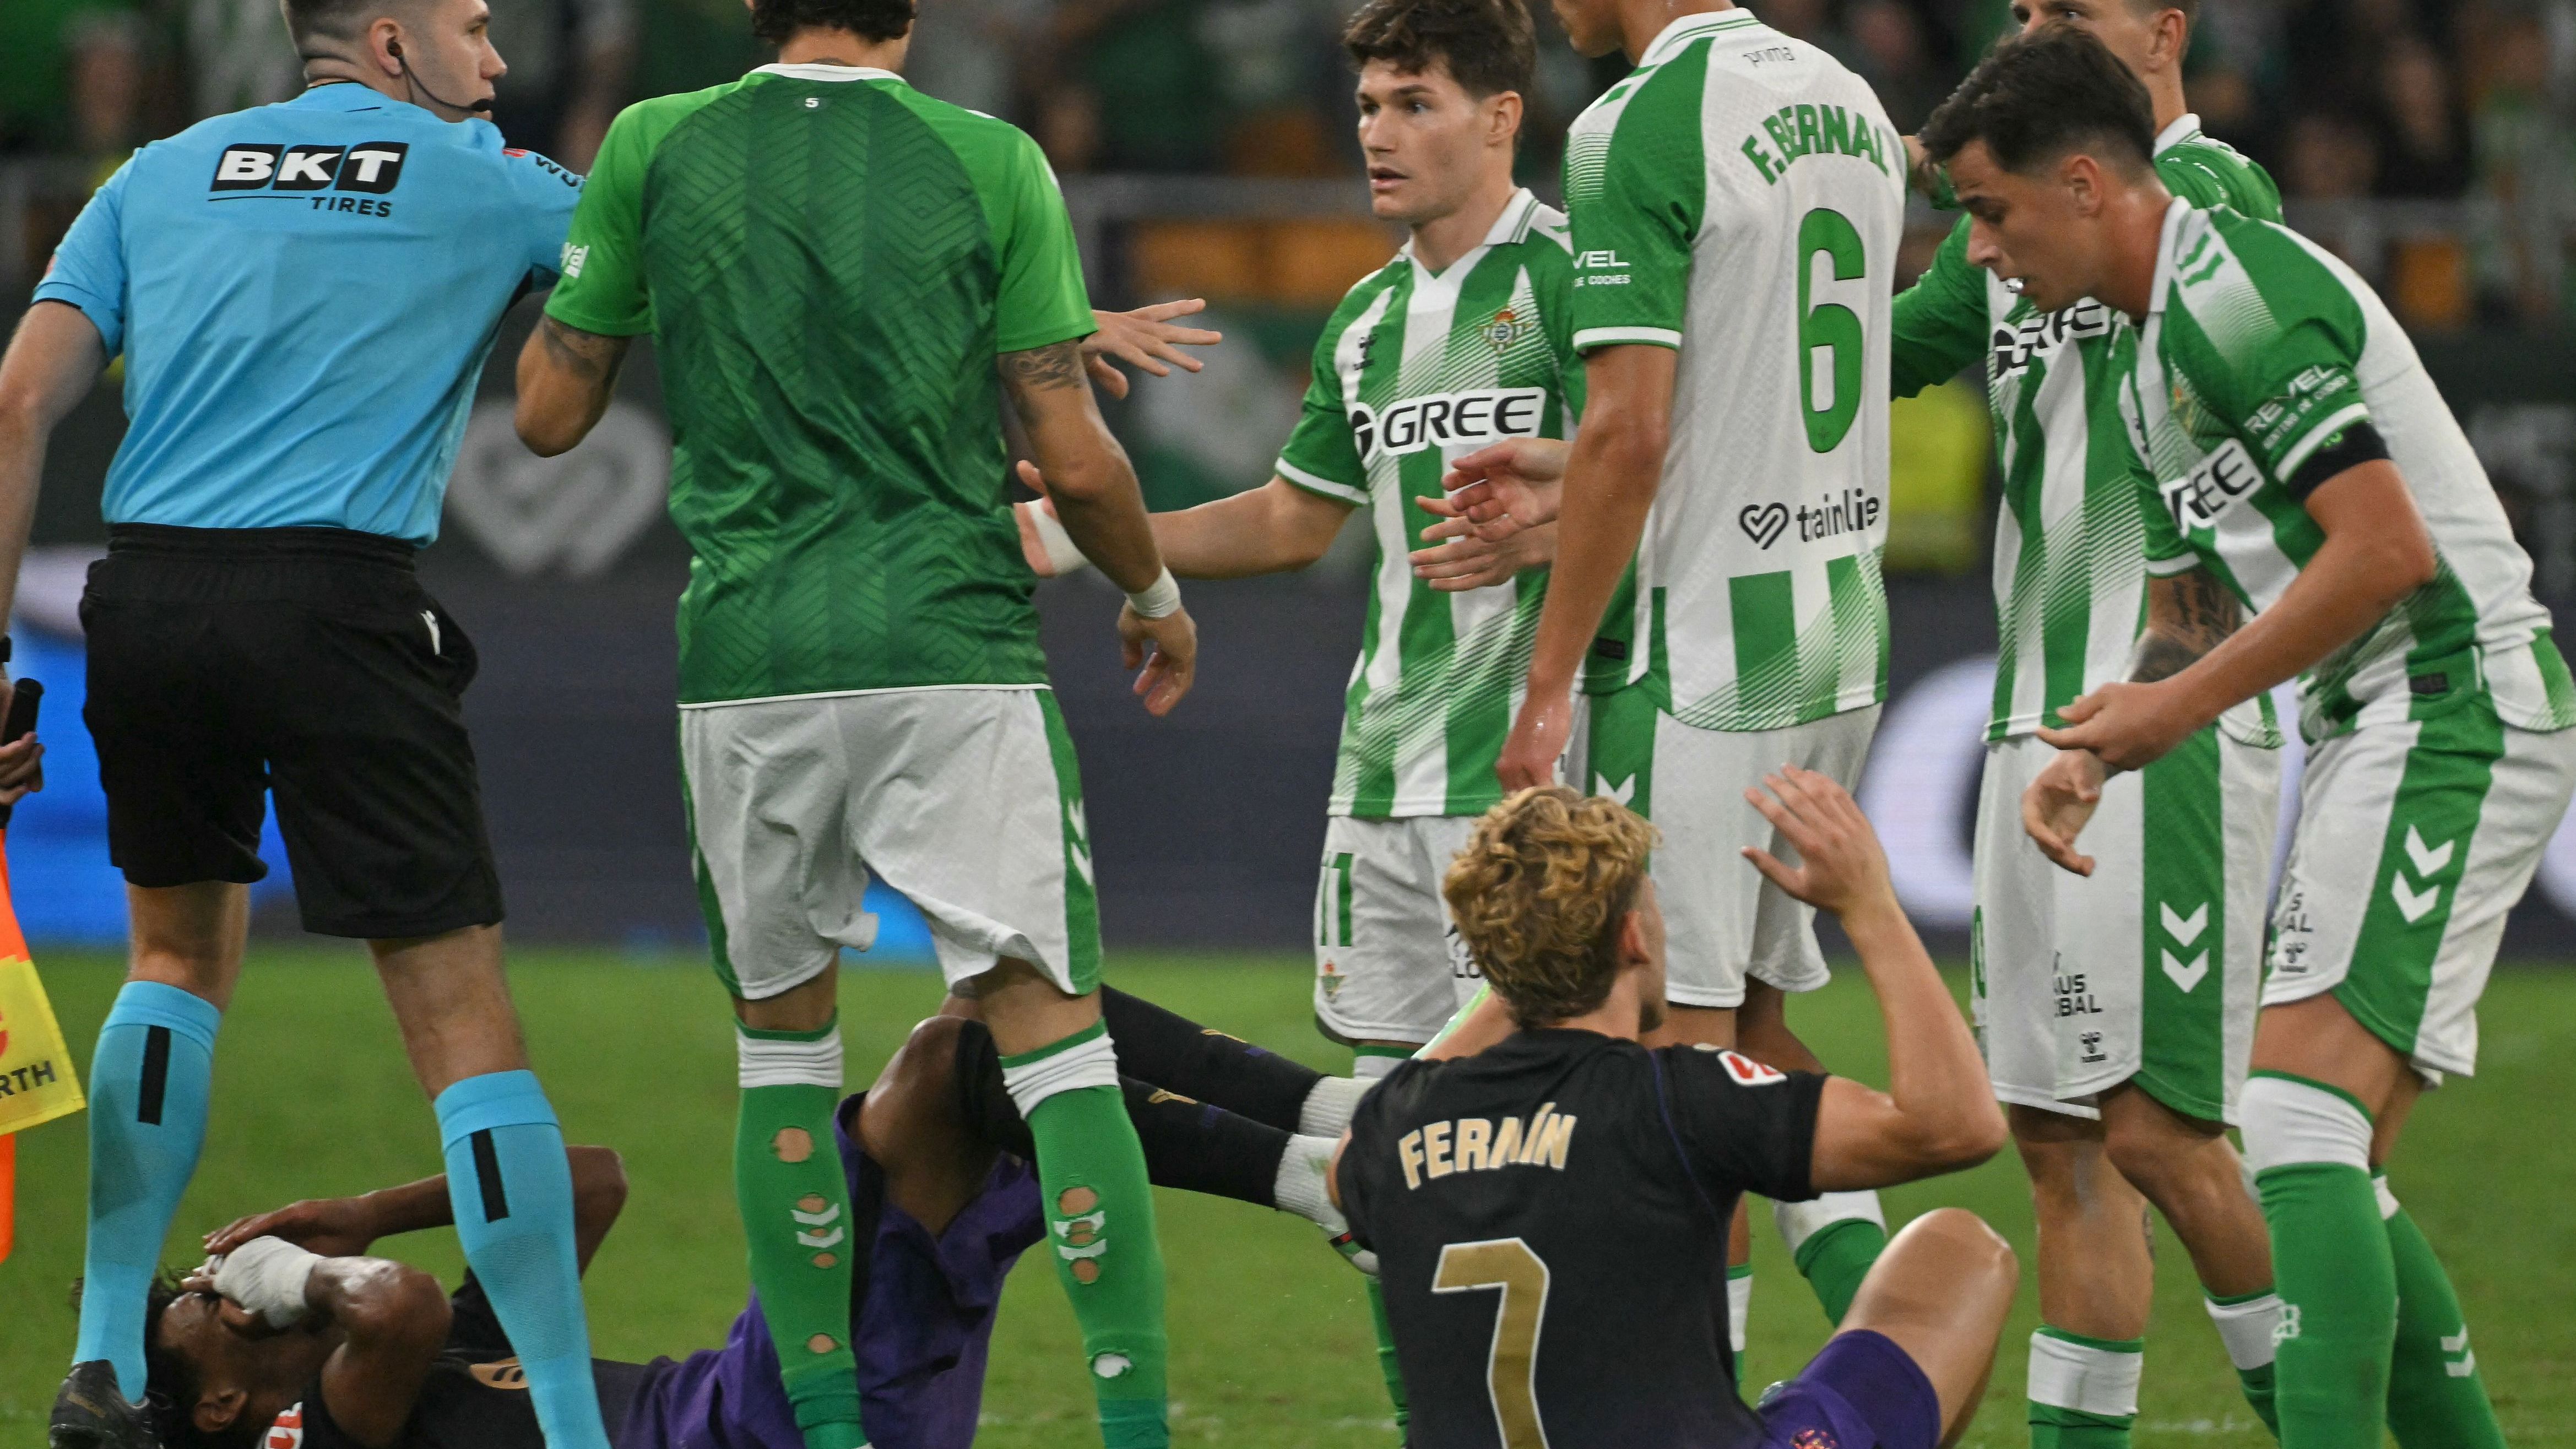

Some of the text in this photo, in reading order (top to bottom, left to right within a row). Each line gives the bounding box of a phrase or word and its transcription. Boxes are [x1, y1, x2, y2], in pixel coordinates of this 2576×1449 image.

[216, 150, 401, 183] BKT
[1740, 104, 1890, 186] F.BERNAL
[311, 197, 393, 218] TIRES
[1798, 208, 1865, 453] 6
[1383, 394, 1538, 448] GREE
[2244, 365, 2338, 434] REVEL
[1433, 1238, 1550, 1449] 7
